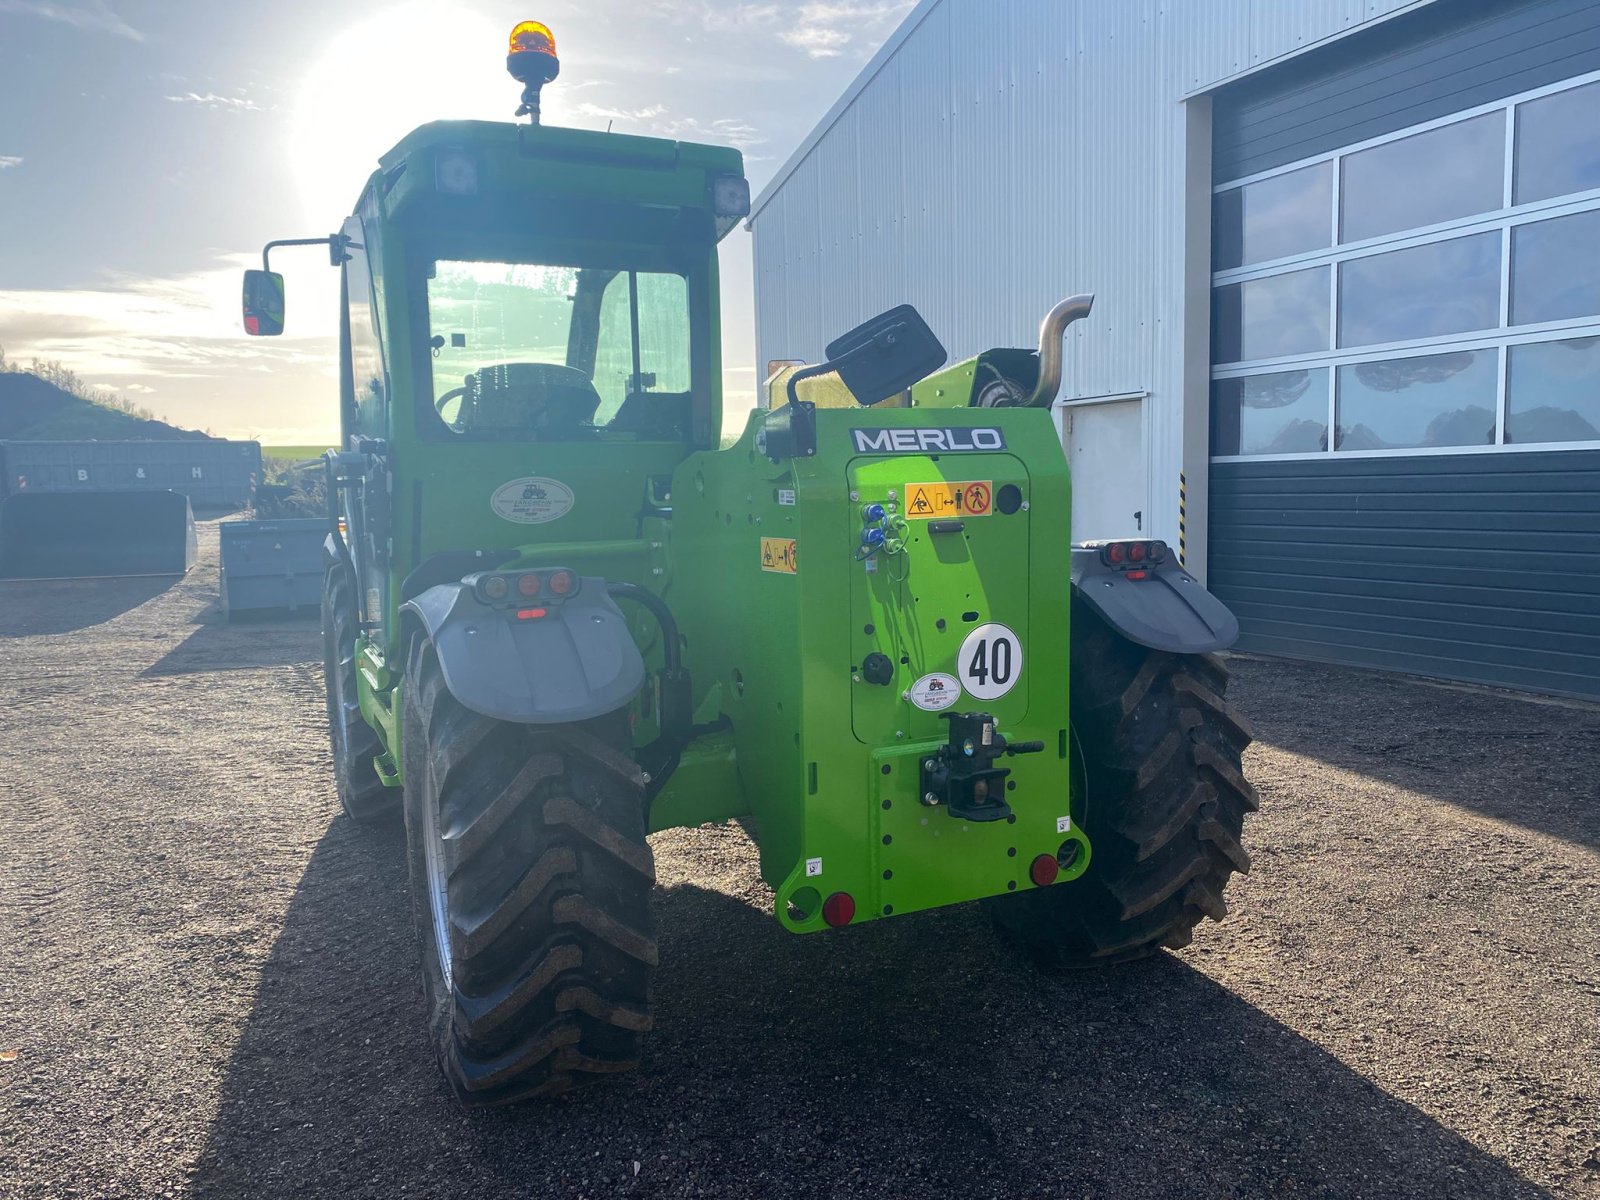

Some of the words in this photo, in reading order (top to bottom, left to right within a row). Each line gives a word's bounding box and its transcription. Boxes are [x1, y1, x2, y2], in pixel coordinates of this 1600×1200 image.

[854, 428, 1002, 451] MERLO
[77, 469, 88, 481] B
[136, 467, 146, 478] &
[192, 467, 202, 478] H
[969, 637, 1011, 686] 40
